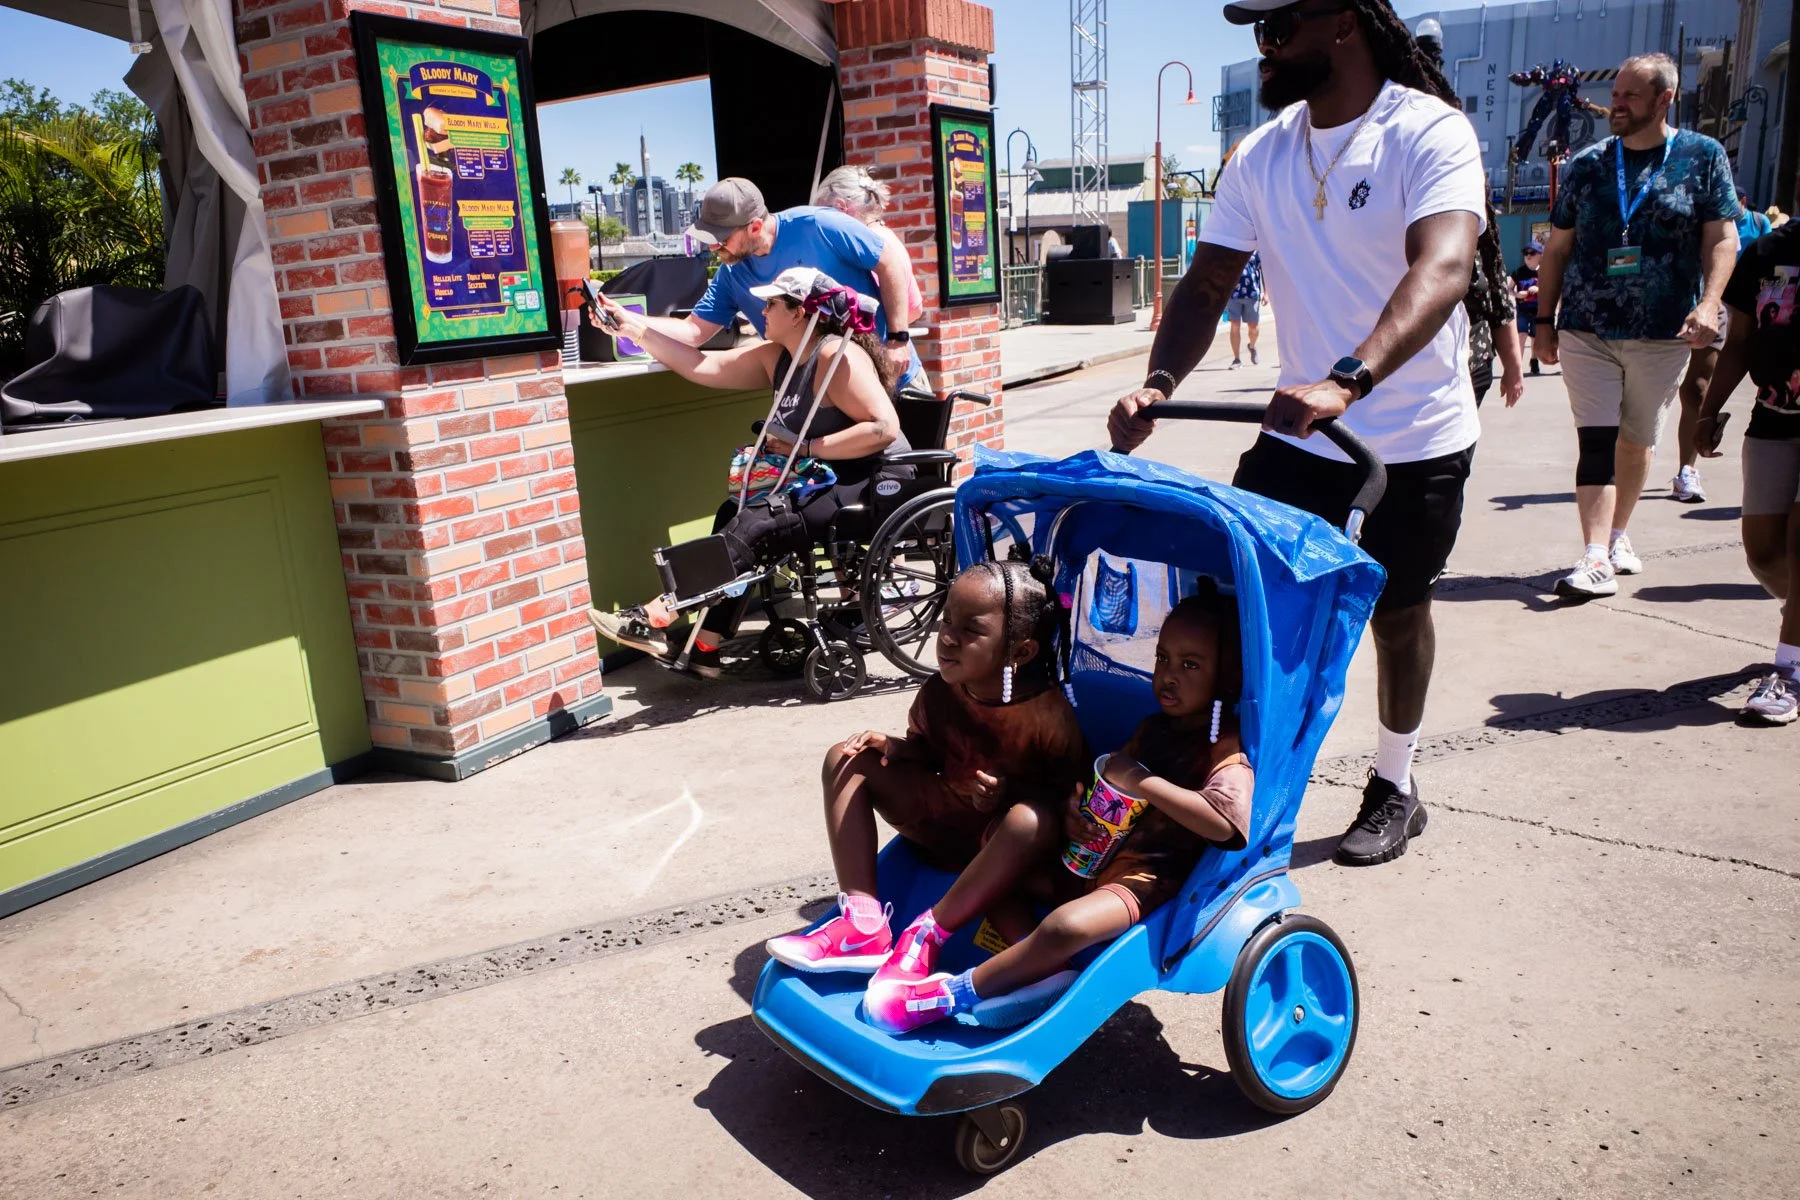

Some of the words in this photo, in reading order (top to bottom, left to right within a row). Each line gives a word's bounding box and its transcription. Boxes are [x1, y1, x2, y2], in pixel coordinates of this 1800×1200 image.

[420, 67, 451, 80] BLOODY
[454, 67, 478, 85] MARY
[877, 483, 900, 491] drive
